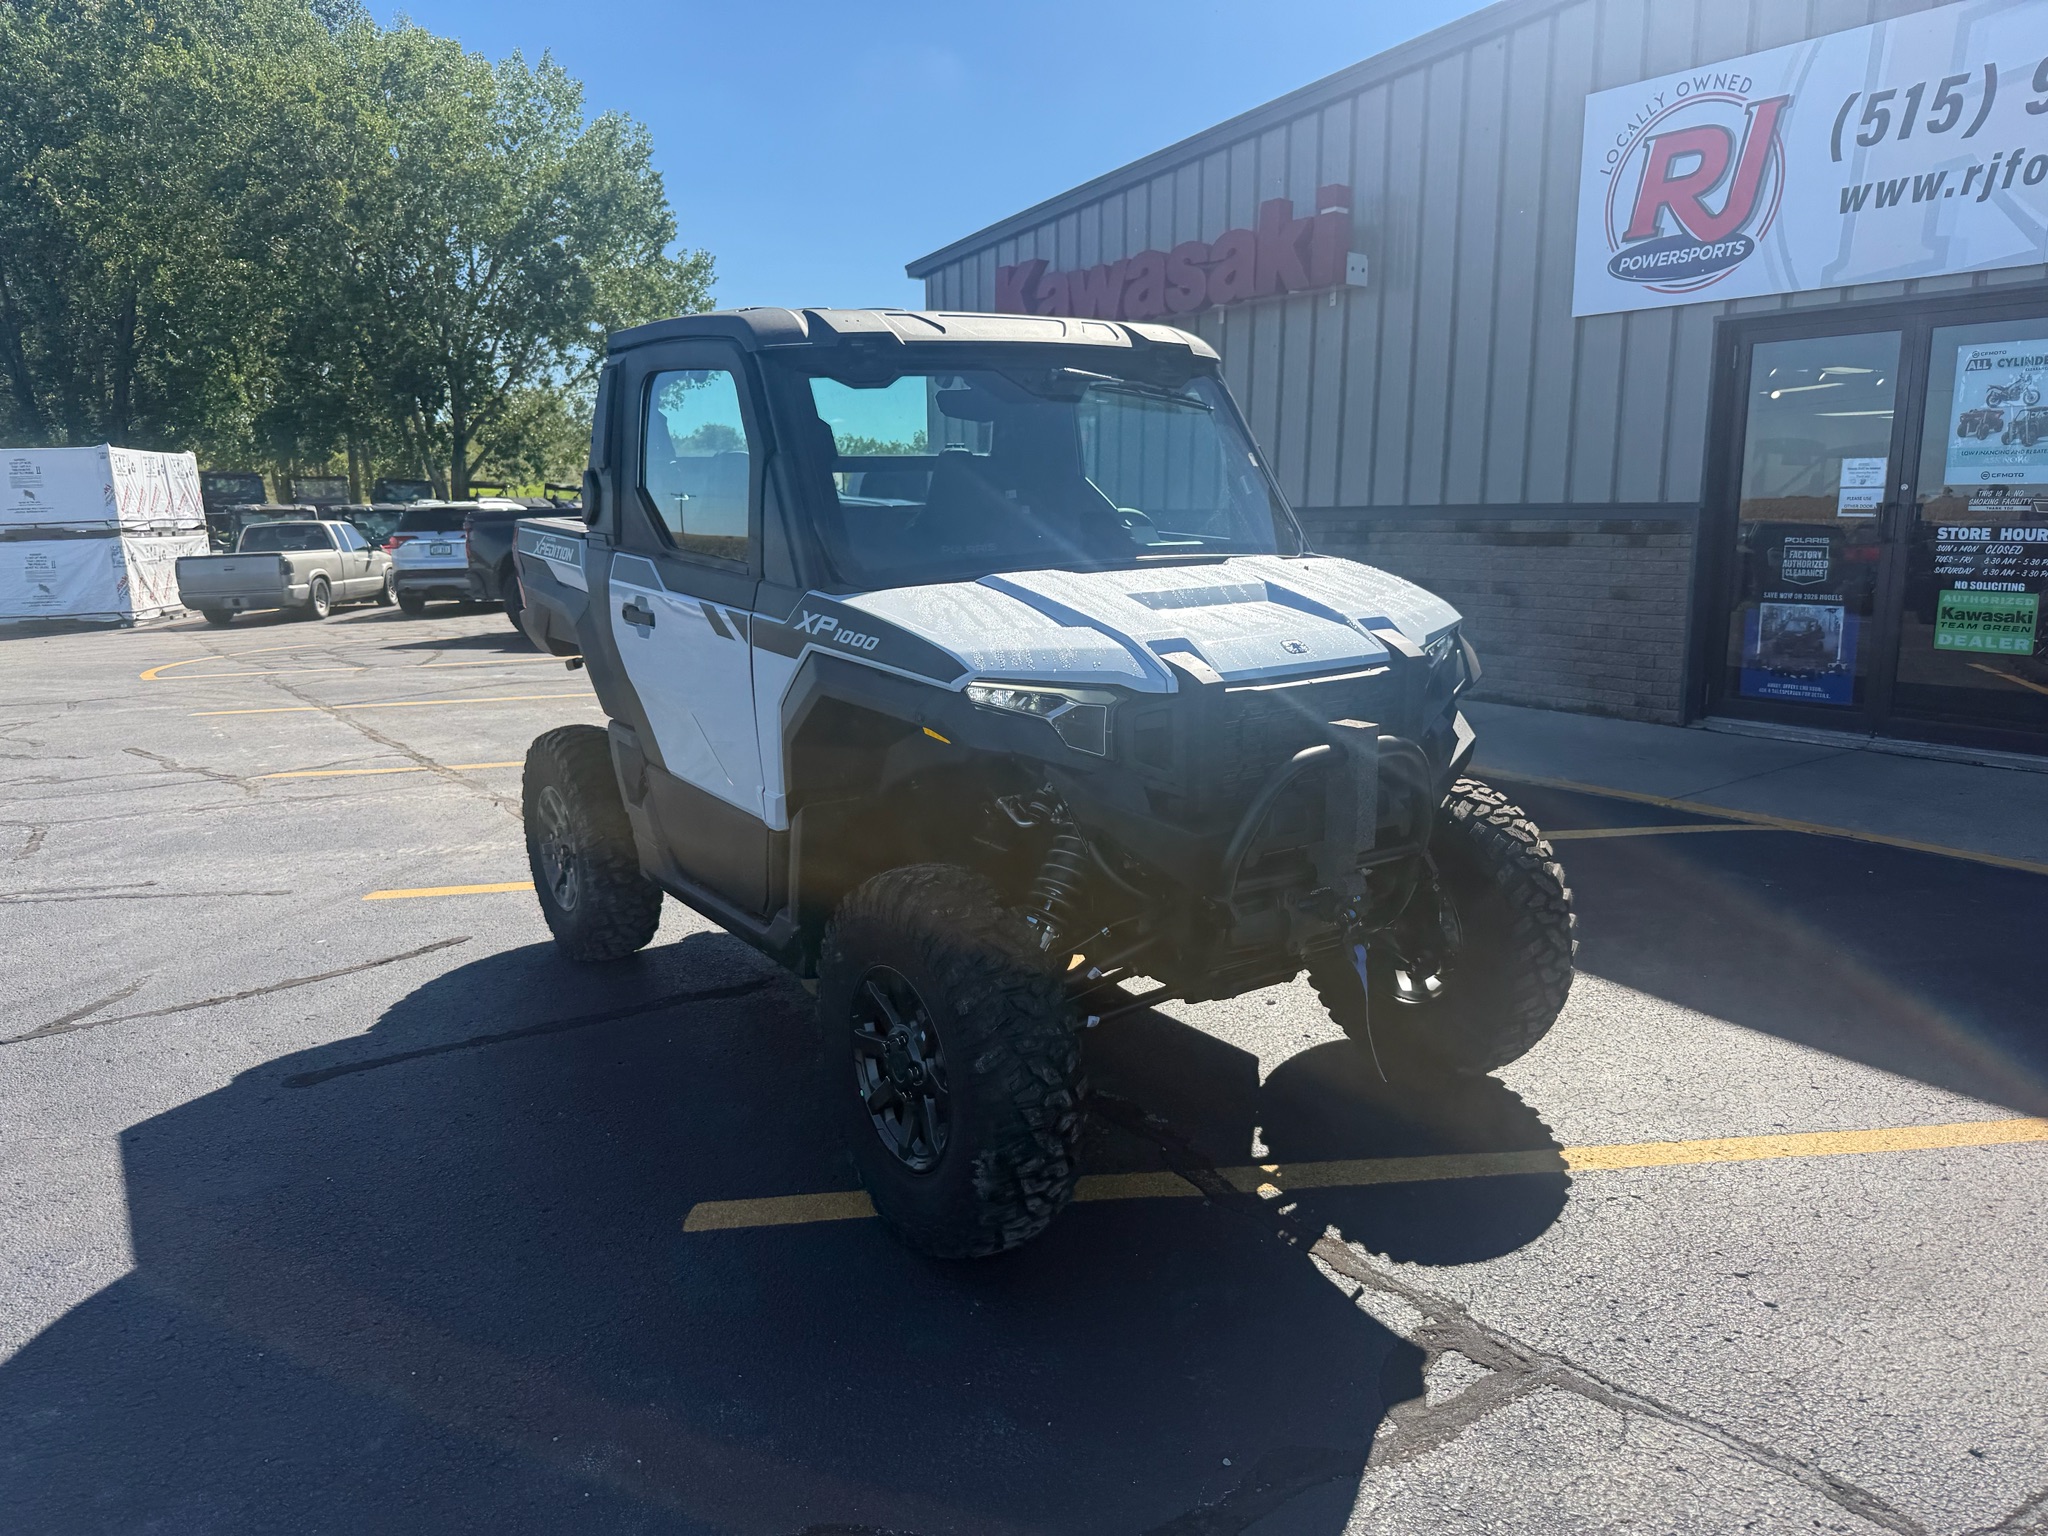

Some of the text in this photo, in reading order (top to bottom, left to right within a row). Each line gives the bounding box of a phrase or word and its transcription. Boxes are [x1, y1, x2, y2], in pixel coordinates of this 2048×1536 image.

[1830, 62, 1998, 163] (515)
[1600, 73, 1752, 175] LOCALLY OWNED
[1621, 94, 1793, 242] RJ
[1839, 147, 2048, 214] www.rjfo
[995, 183, 1353, 322] Kawasaki
[1619, 240, 1746, 272] POWERSPORTS
[1966, 359, 1991, 371] ALL
[2013, 489, 2025, 497] NO
[1936, 527, 1992, 540] STORE
[533, 535, 574, 562] XPEDITION
[1789, 550, 1822, 559] FACTORY
[1959, 545, 1979, 553] MON
[1985, 544, 2023, 555] CLOSED
[1782, 559, 1829, 568] AUTHORIZED
[1959, 556, 1973, 564] FRI
[2001, 557, 2017, 565] AM
[1785, 568, 1824, 577] CLEARANCE
[1933, 567, 1975, 575] SATURDAY
[2000, 568, 2016, 577] AM
[1954, 580, 2025, 592] NO SOLICITING
[1943, 594, 2034, 606] AUTHORIZED
[1941, 606, 2033, 624] Kawasaki
[793, 609, 880, 651] XP 1000
[1940, 622, 2031, 633] TEAM GREEN
[1937, 633, 2030, 651] DEALER
